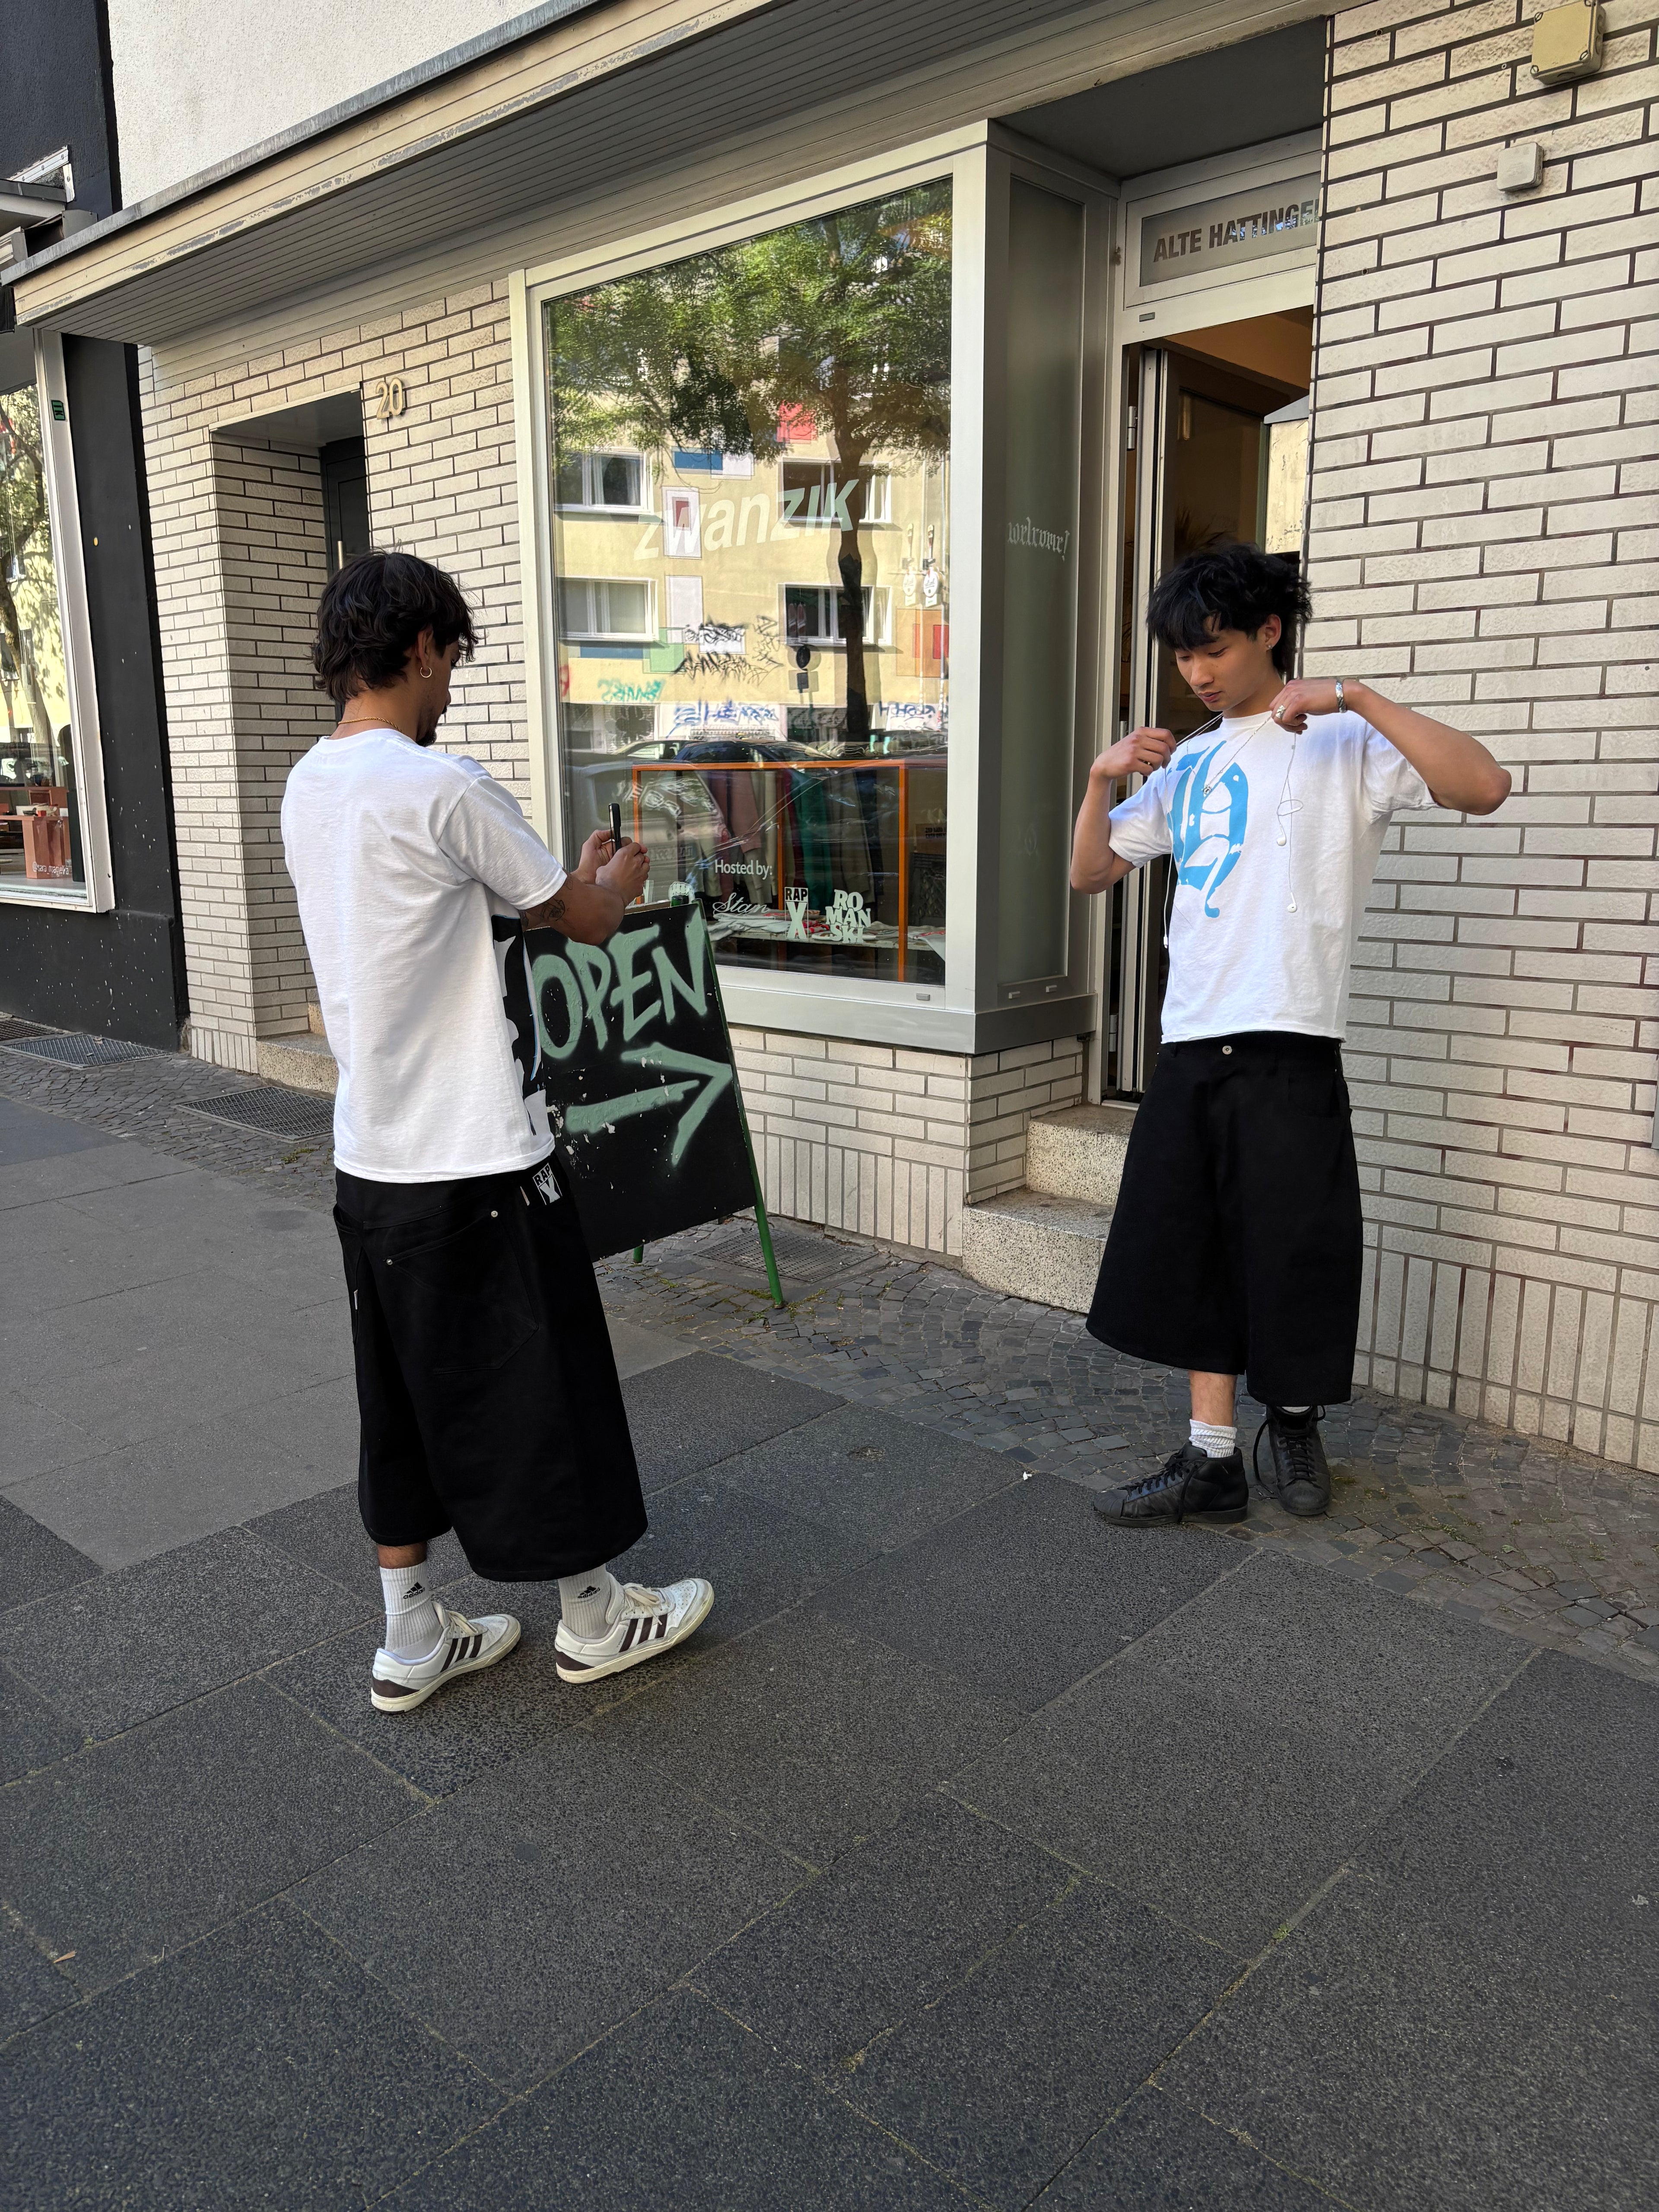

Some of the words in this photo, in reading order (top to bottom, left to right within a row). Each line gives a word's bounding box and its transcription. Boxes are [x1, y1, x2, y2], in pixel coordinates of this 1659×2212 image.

[1154, 229, 1201, 263] ALTE
[375, 377, 403, 420] 20
[715, 859, 754, 874] Hosted
[756, 860, 772, 880] by:
[712, 892, 769, 915] Stan
[785, 888, 807, 901] RAP
[833, 889, 864, 912] RO
[786, 901, 807, 940] X
[825, 906, 871, 928] MAN
[532, 906, 708, 1059] OPEN
[534, 1165, 550, 1186] RAP
